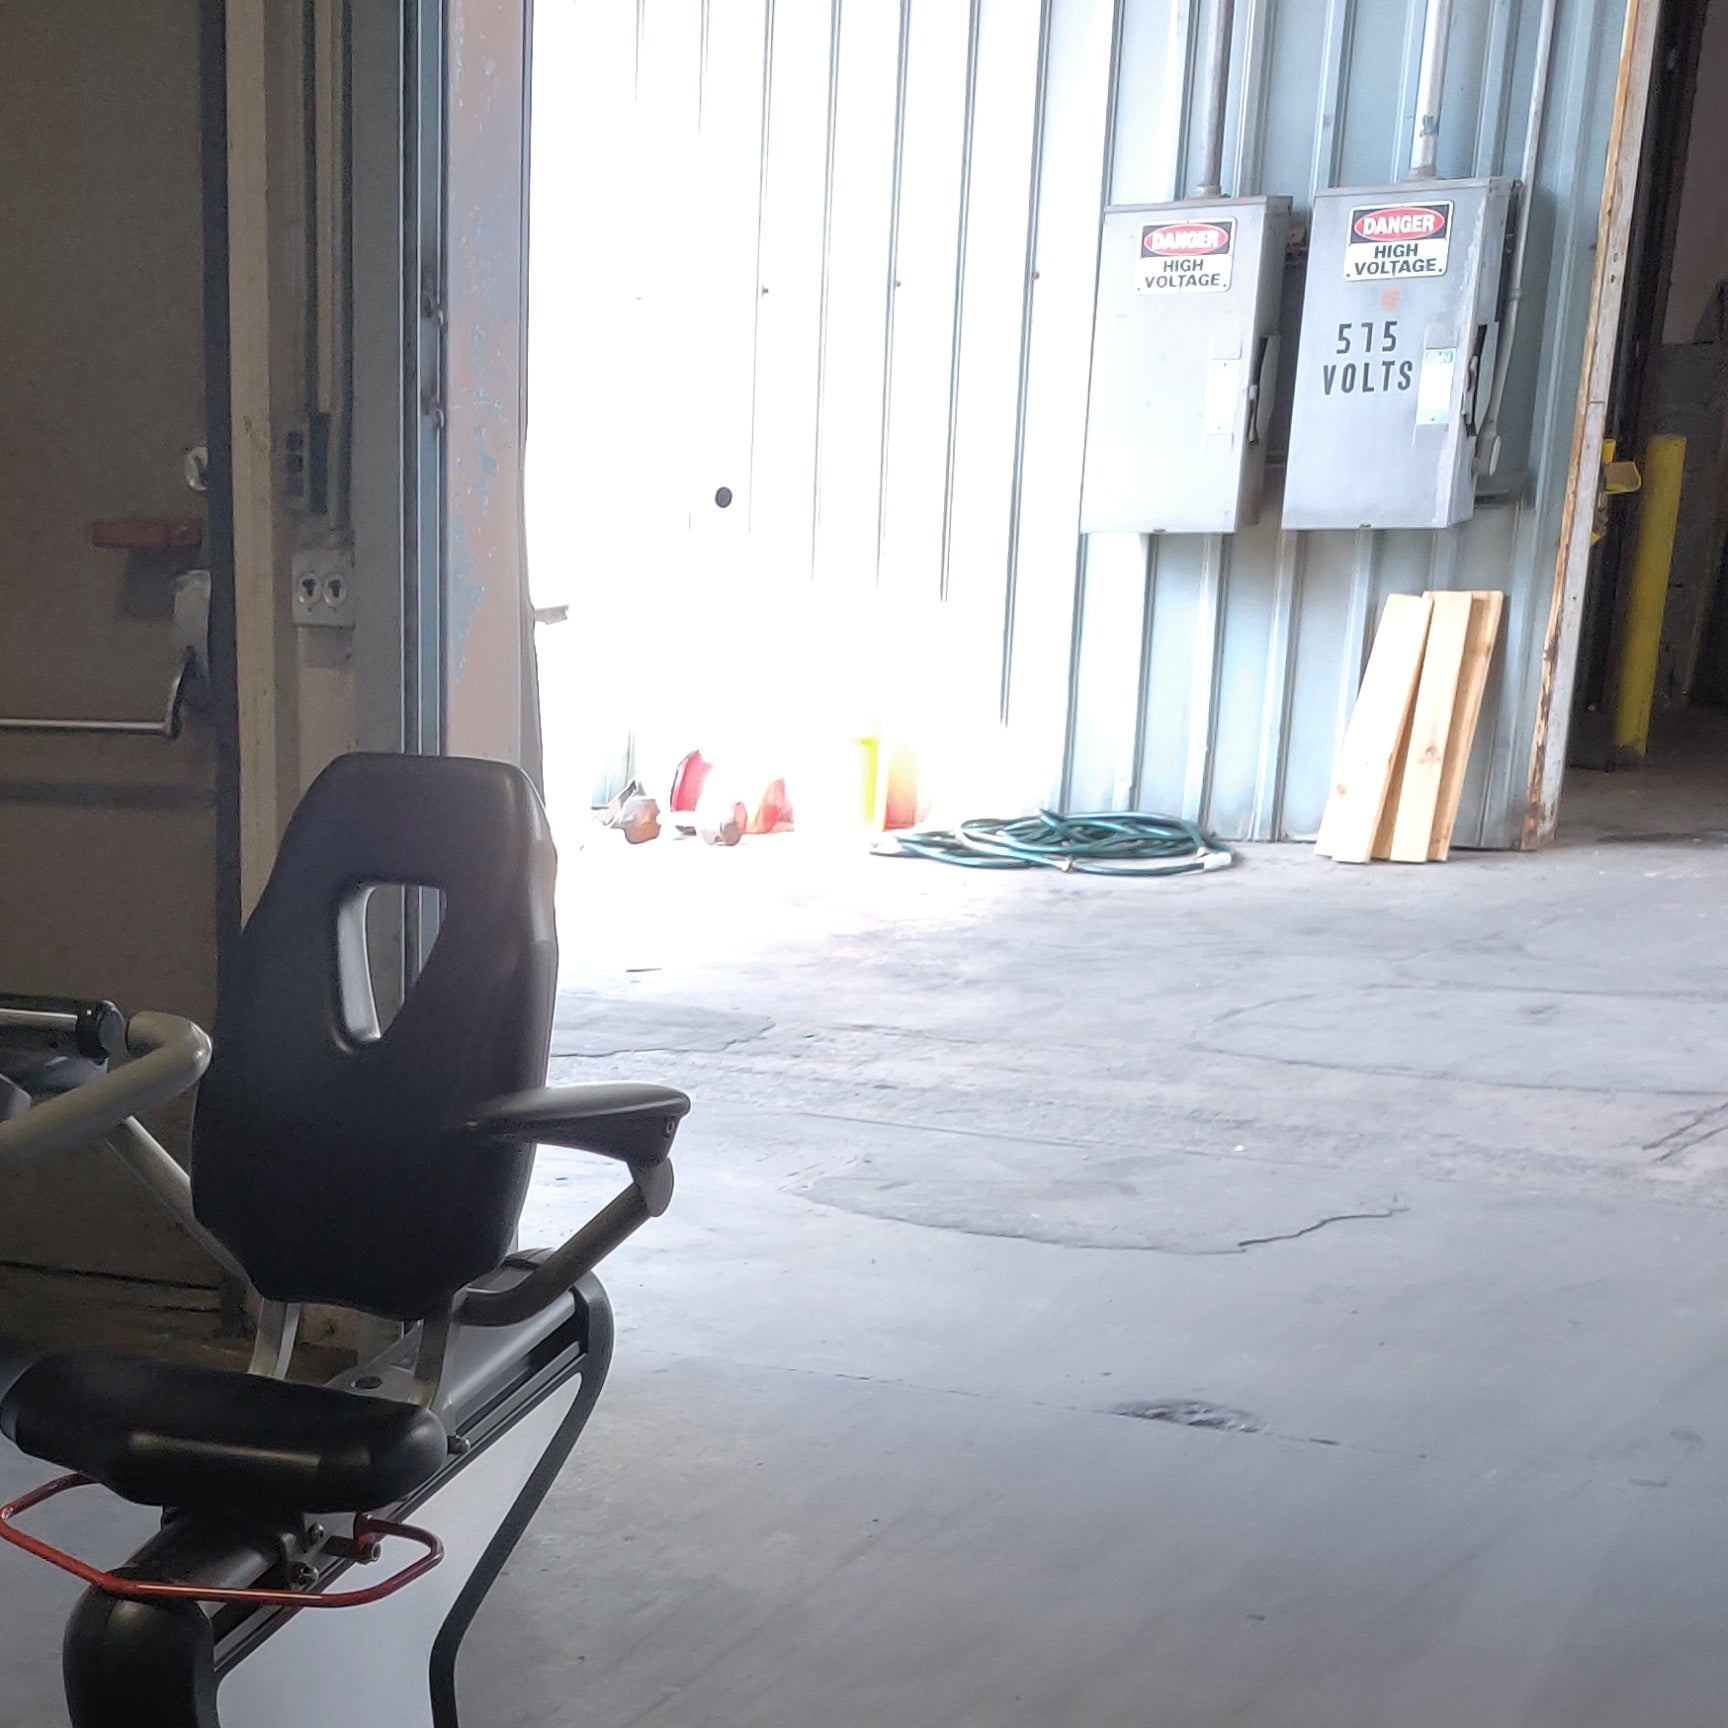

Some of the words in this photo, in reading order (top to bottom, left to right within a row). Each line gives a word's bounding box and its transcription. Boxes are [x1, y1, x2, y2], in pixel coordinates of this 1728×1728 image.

[1362, 214, 1436, 236] DANGER
[1151, 229, 1220, 251] DANGER
[1374, 243, 1419, 259] HIGH
[1163, 258, 1204, 272] HIGH
[1354, 258, 1437, 276] VOLTAGE
[1145, 273, 1221, 288] VOLTAGE
[1336, 320, 1398, 354] 575
[1323, 360, 1413, 395] VOLTS
